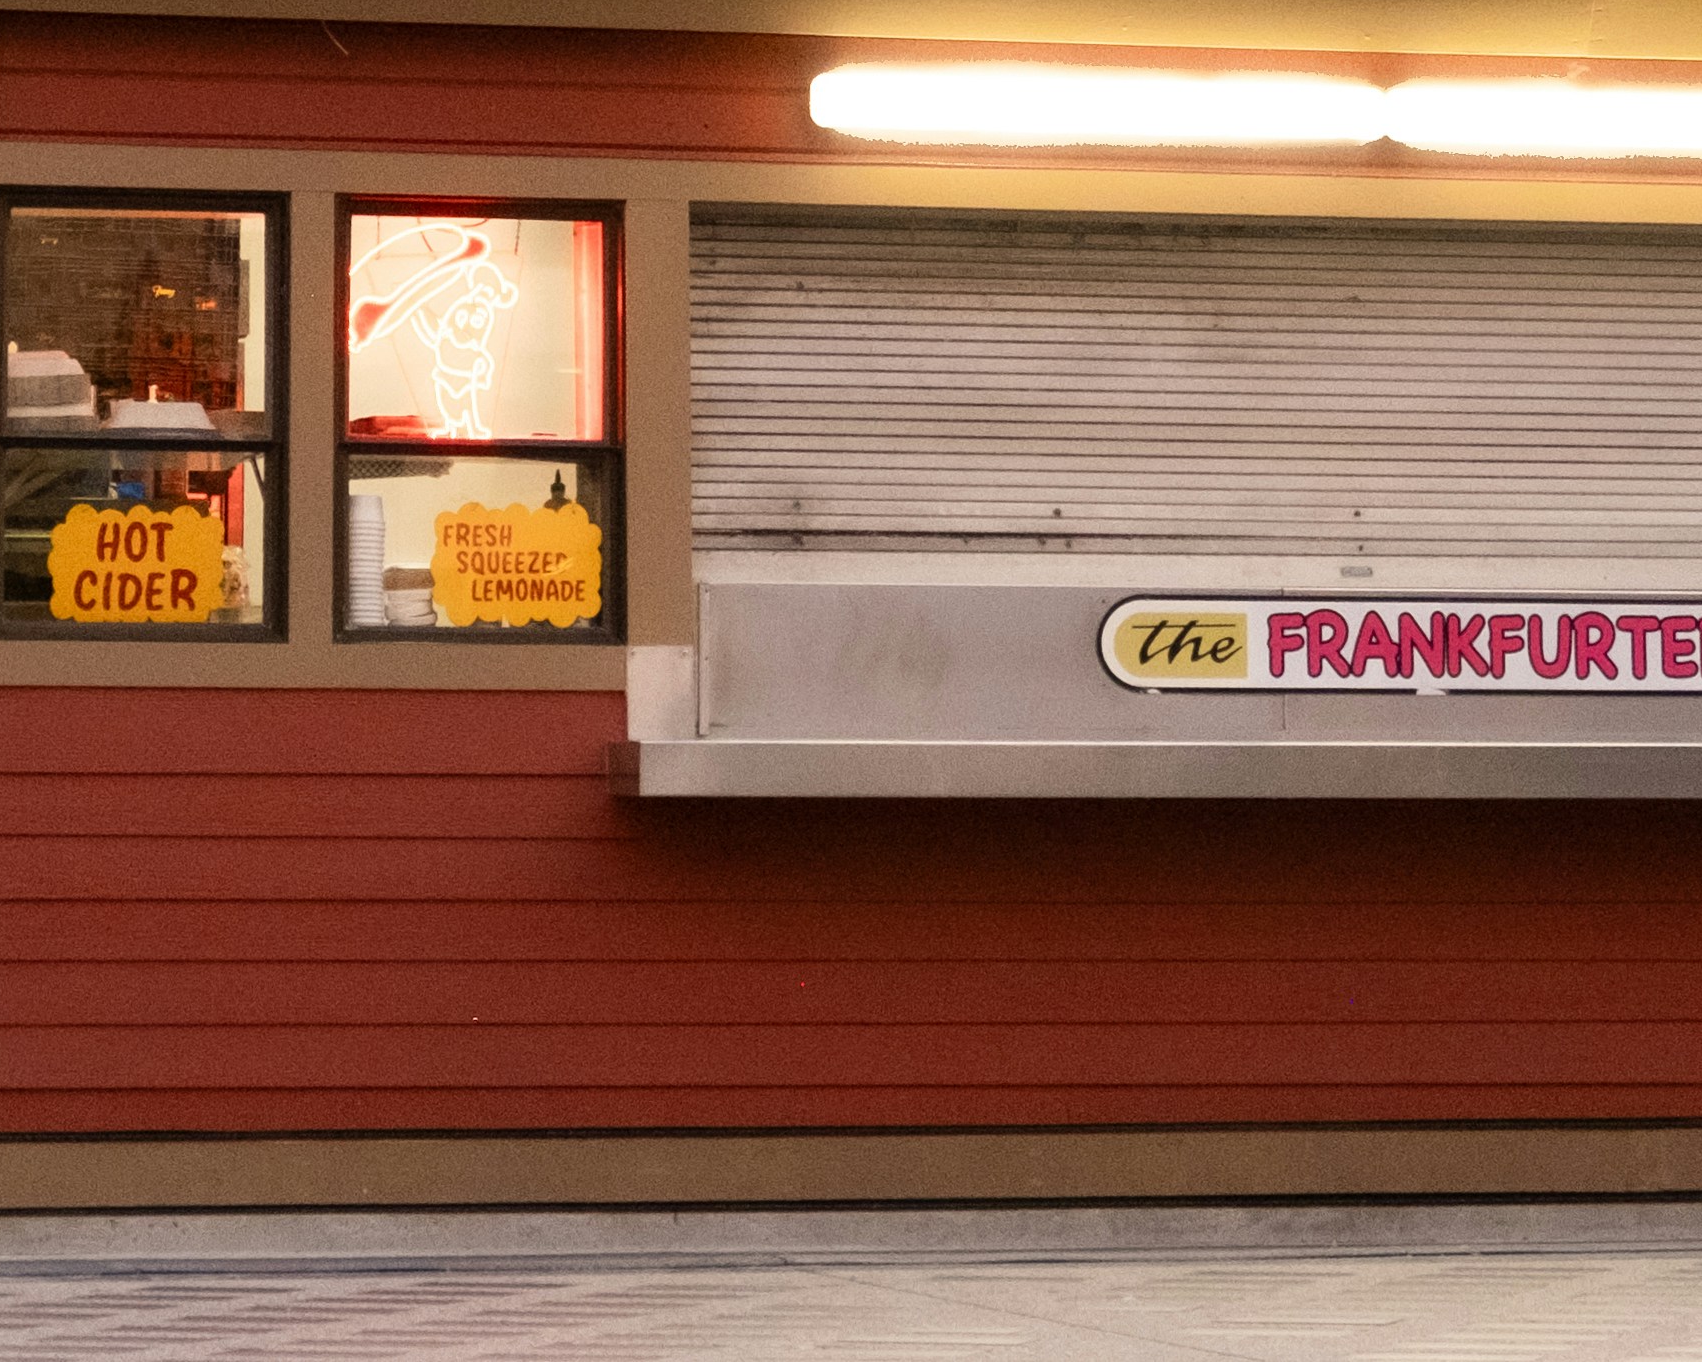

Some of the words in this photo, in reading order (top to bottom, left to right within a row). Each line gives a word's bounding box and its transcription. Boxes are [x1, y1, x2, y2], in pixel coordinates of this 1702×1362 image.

[97, 521, 174, 563] HOT
[443, 523, 513, 548] FRESH
[74, 568, 198, 612] CIDER
[471, 579, 586, 602] LEMONADE
[1131, 620, 1243, 665] the
